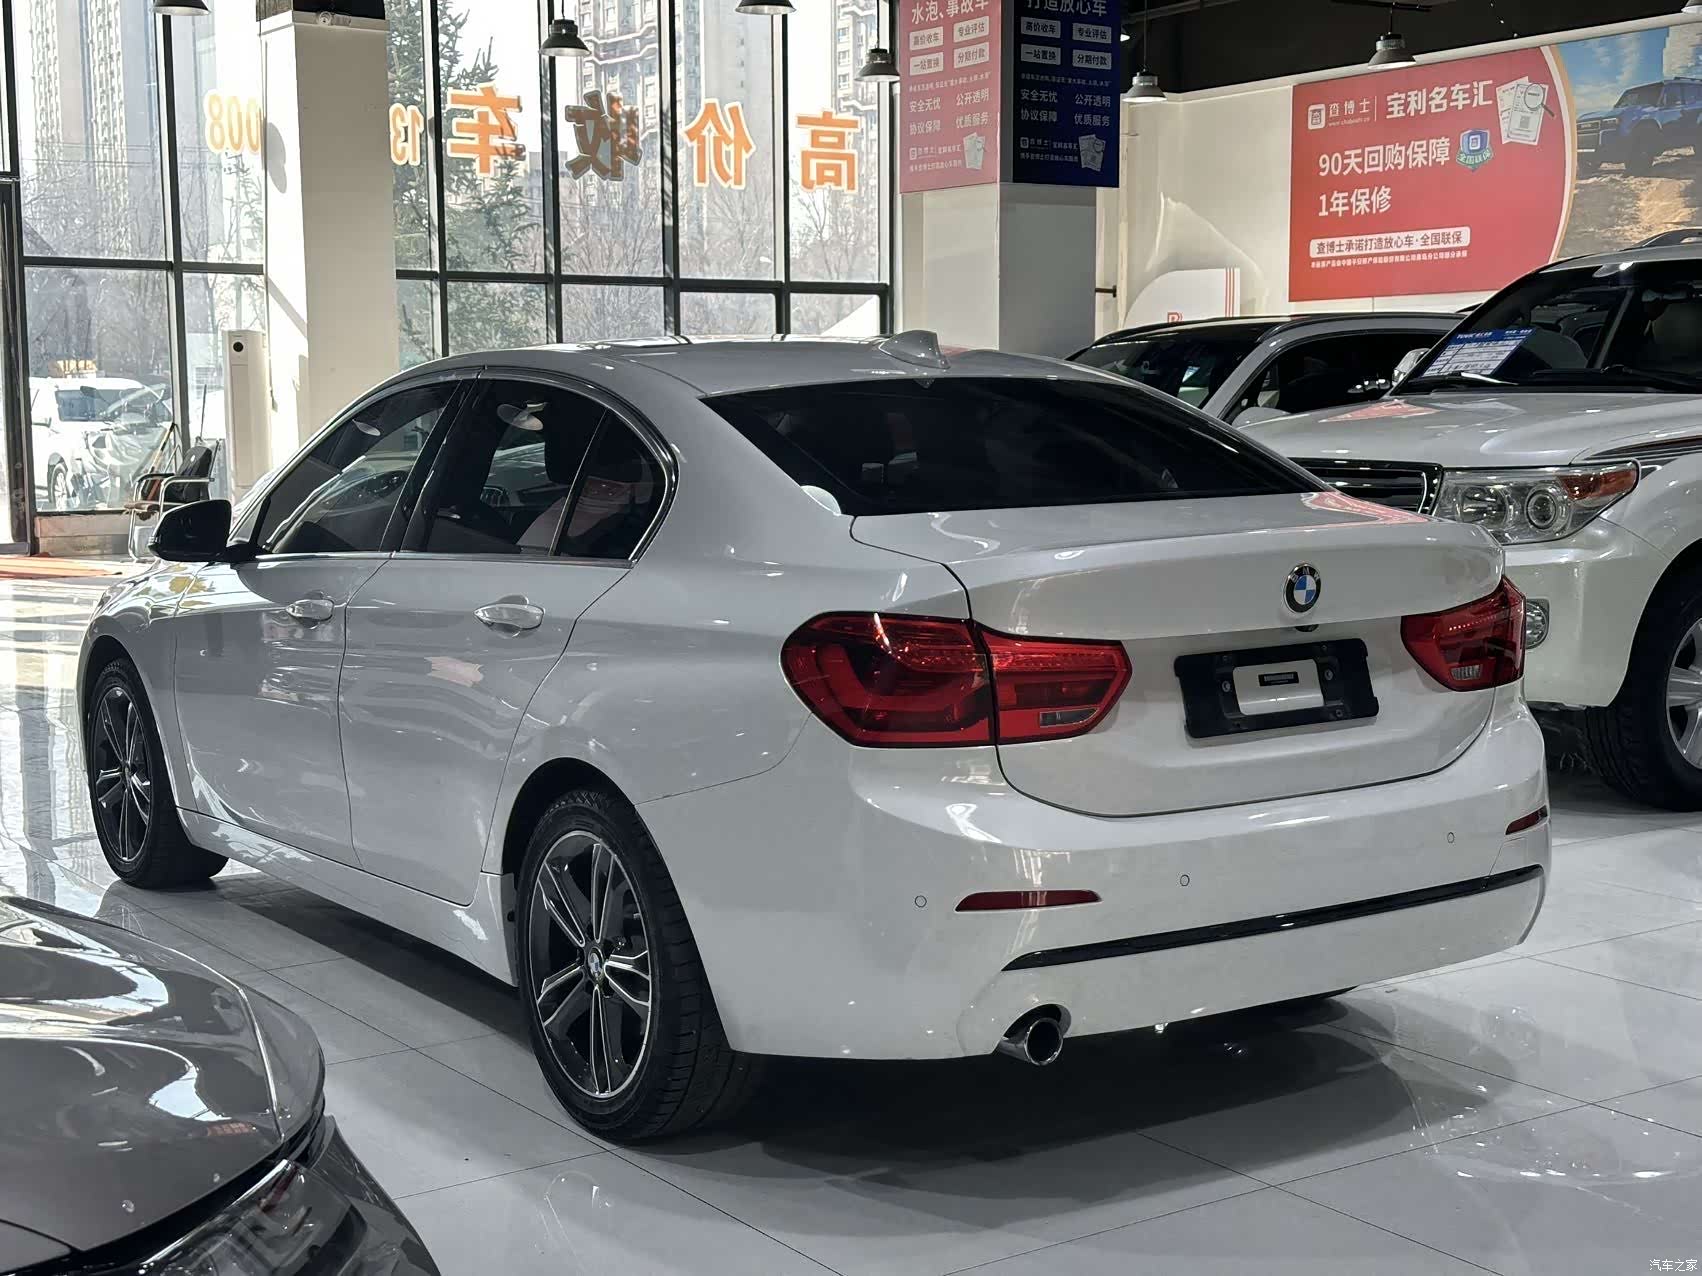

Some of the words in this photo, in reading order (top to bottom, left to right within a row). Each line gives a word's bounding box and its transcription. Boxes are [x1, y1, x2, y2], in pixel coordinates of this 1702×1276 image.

[958, 22, 985, 37] 专业评估
[1025, 21, 1056, 34] 高价收车
[1077, 27, 1107, 40] 专业评估
[957, 48, 986, 63] 分期付款
[1077, 54, 1107, 66] 分期付款
[956, 87, 990, 106] 公开透明
[1020, 88, 1058, 103] 安全无忧
[1074, 93, 1111, 108] 公开透明
[1386, 80, 1493, 119] 宝利名车汇
[909, 96, 941, 113] 安全无忧
[1329, 98, 1370, 117] 查博士
[955, 111, 989, 129] 优质服务
[1020, 106, 1058, 122] 协议保障
[1074, 112, 1111, 127] 优质服务
[909, 119, 941, 136] 协议保障
[1318, 136, 1451, 177] 90天回购保障
[1318, 186, 1392, 217] 1年保修
